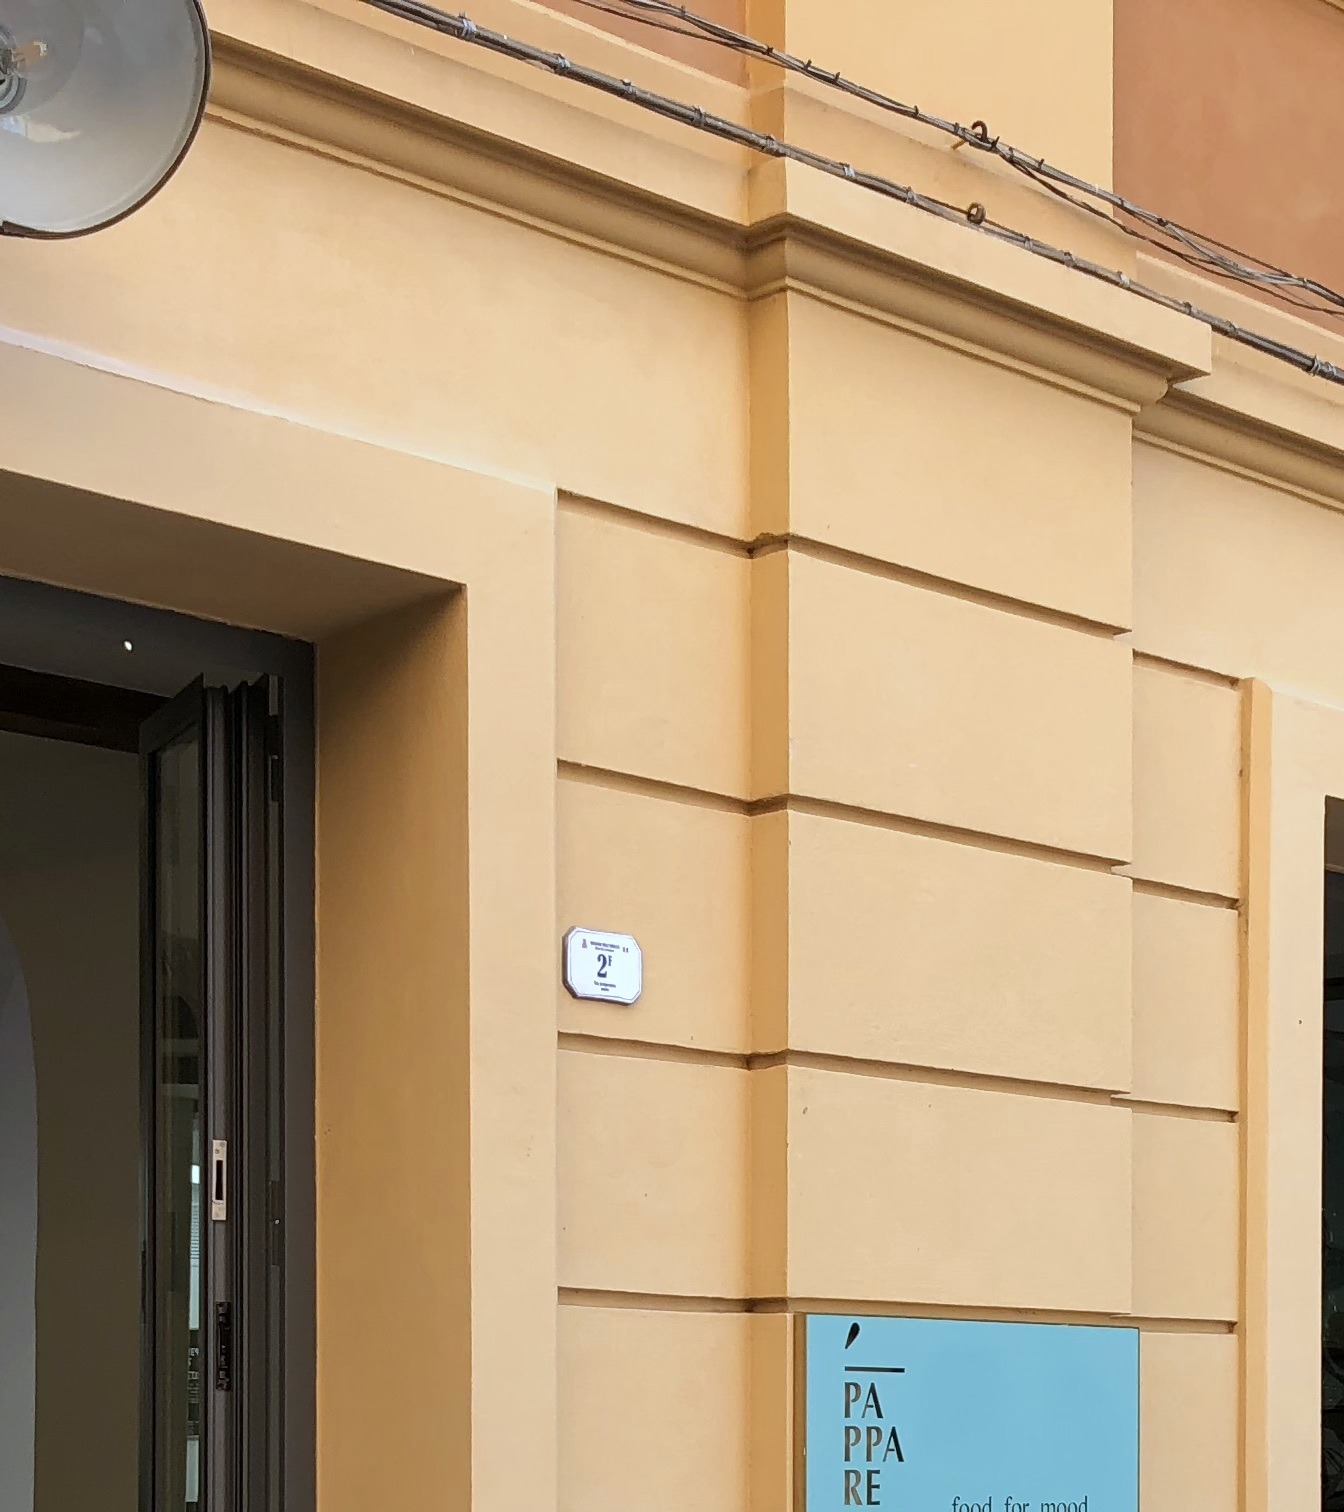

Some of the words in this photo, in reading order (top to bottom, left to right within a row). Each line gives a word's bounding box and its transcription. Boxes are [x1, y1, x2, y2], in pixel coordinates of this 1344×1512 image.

[844, 1381, 884, 1419] PA
[844, 1425, 905, 1463] PPA
[844, 1469, 881, 1506] RE
